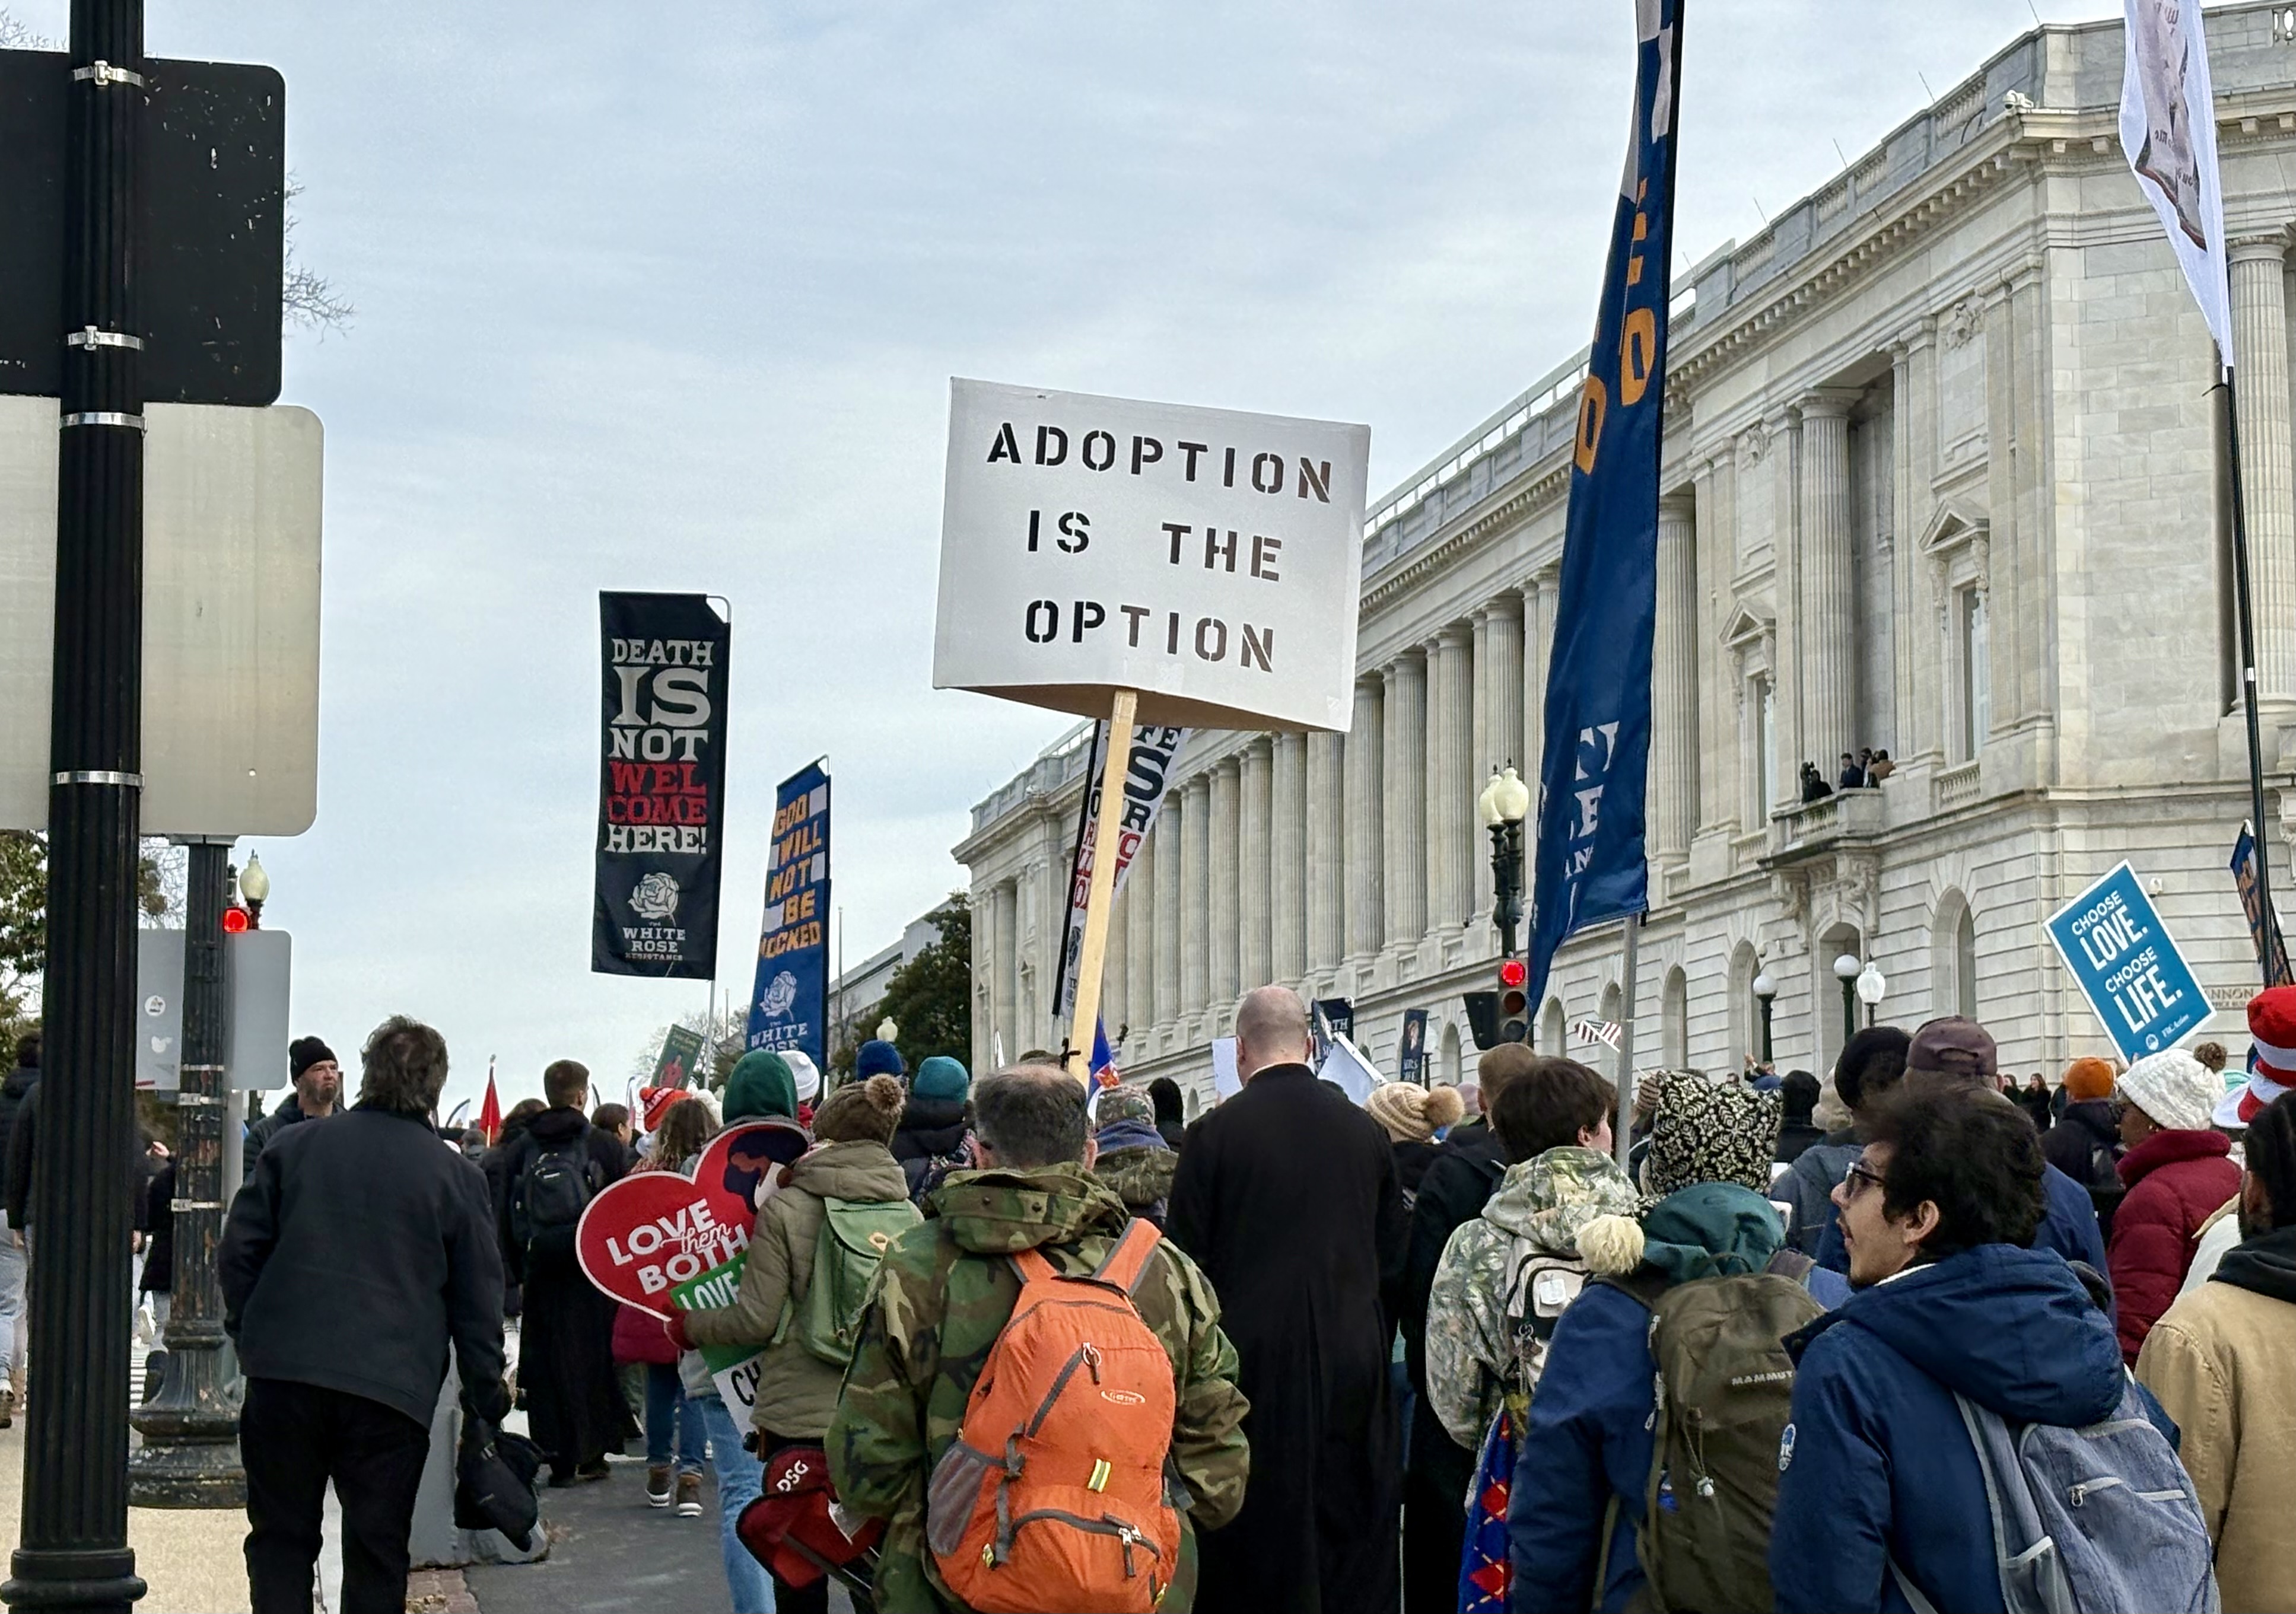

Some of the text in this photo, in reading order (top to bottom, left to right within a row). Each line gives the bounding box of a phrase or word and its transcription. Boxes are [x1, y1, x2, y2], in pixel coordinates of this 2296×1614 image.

[987, 422, 1331, 503] ADOPTION
[1028, 510, 1282, 582] IS THE
[611, 638, 714, 666] DEATH
[1025, 600, 1273, 673] OPTION
[610, 666, 711, 727] IS
[608, 727, 708, 762] NOT
[608, 761, 707, 795] WEL
[607, 795, 707, 824] COME
[773, 794, 807, 837] GOD
[1090, 790, 1152, 833] OR
[605, 823, 707, 854] HERE!
[780, 820, 822, 865] WILL
[769, 857, 811, 902] NOT
[785, 888, 816, 925] BE
[2072, 890, 2122, 935] CHOOSE
[622, 927, 685, 941] WHITE
[631, 940, 678, 953] ROSE
[2079, 904, 2148, 971] LOVE.
[2105, 946, 2157, 992] CHOOSE
[2113, 964, 2183, 1034] LIFE.
[751, 1022, 808, 1048] WHITE
[758, 1039, 799, 1054] OSE
[606, 1198, 715, 1266] LOVE
[659, 1223, 732, 1254] them
[637, 1223, 750, 1295] BOTH
[1732, 1370, 1792, 1386] MAMMUT
[776, 1459, 809, 1492] DSG
